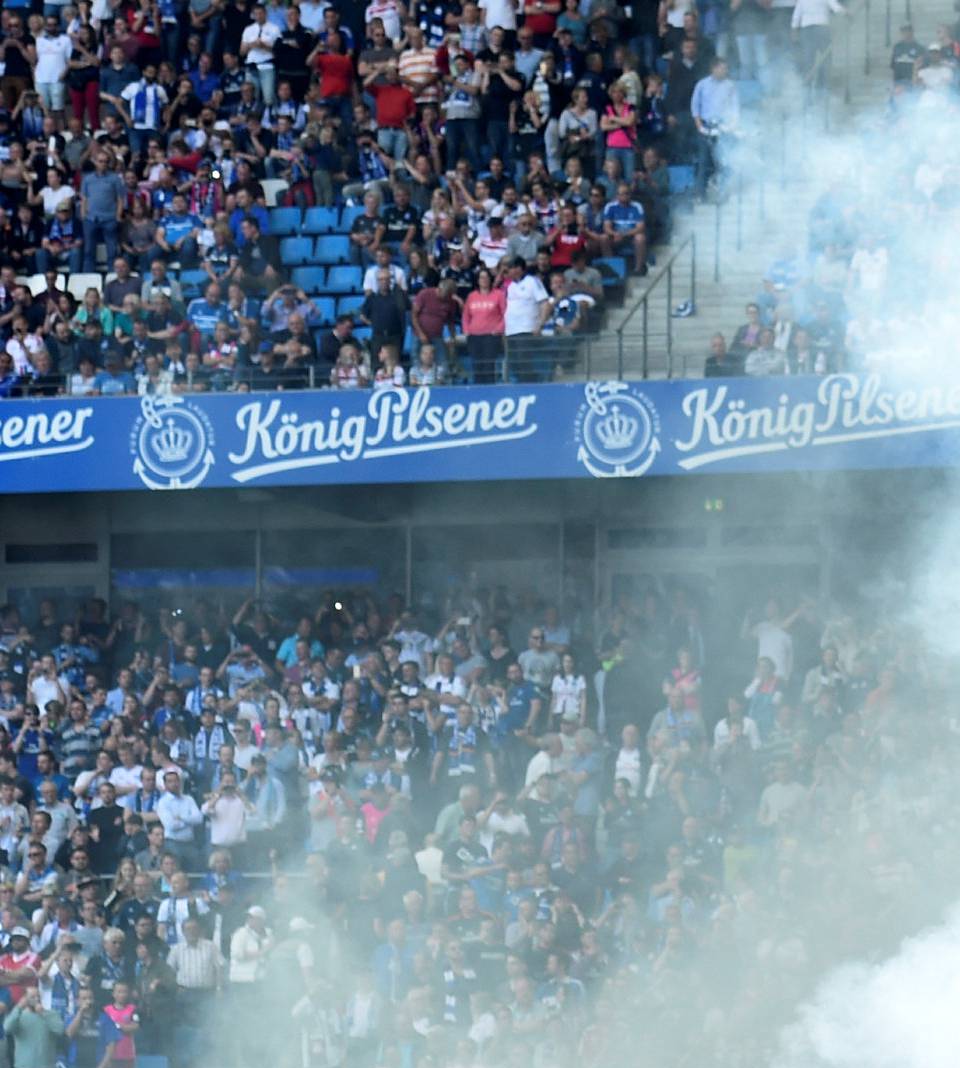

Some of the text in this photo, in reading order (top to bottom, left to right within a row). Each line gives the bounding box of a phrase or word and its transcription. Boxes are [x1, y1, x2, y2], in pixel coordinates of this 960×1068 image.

[0, 407, 94, 448] ener
[228, 398, 366, 461] König
[365, 385, 537, 446] Pilsener
[673, 386, 815, 447] König
